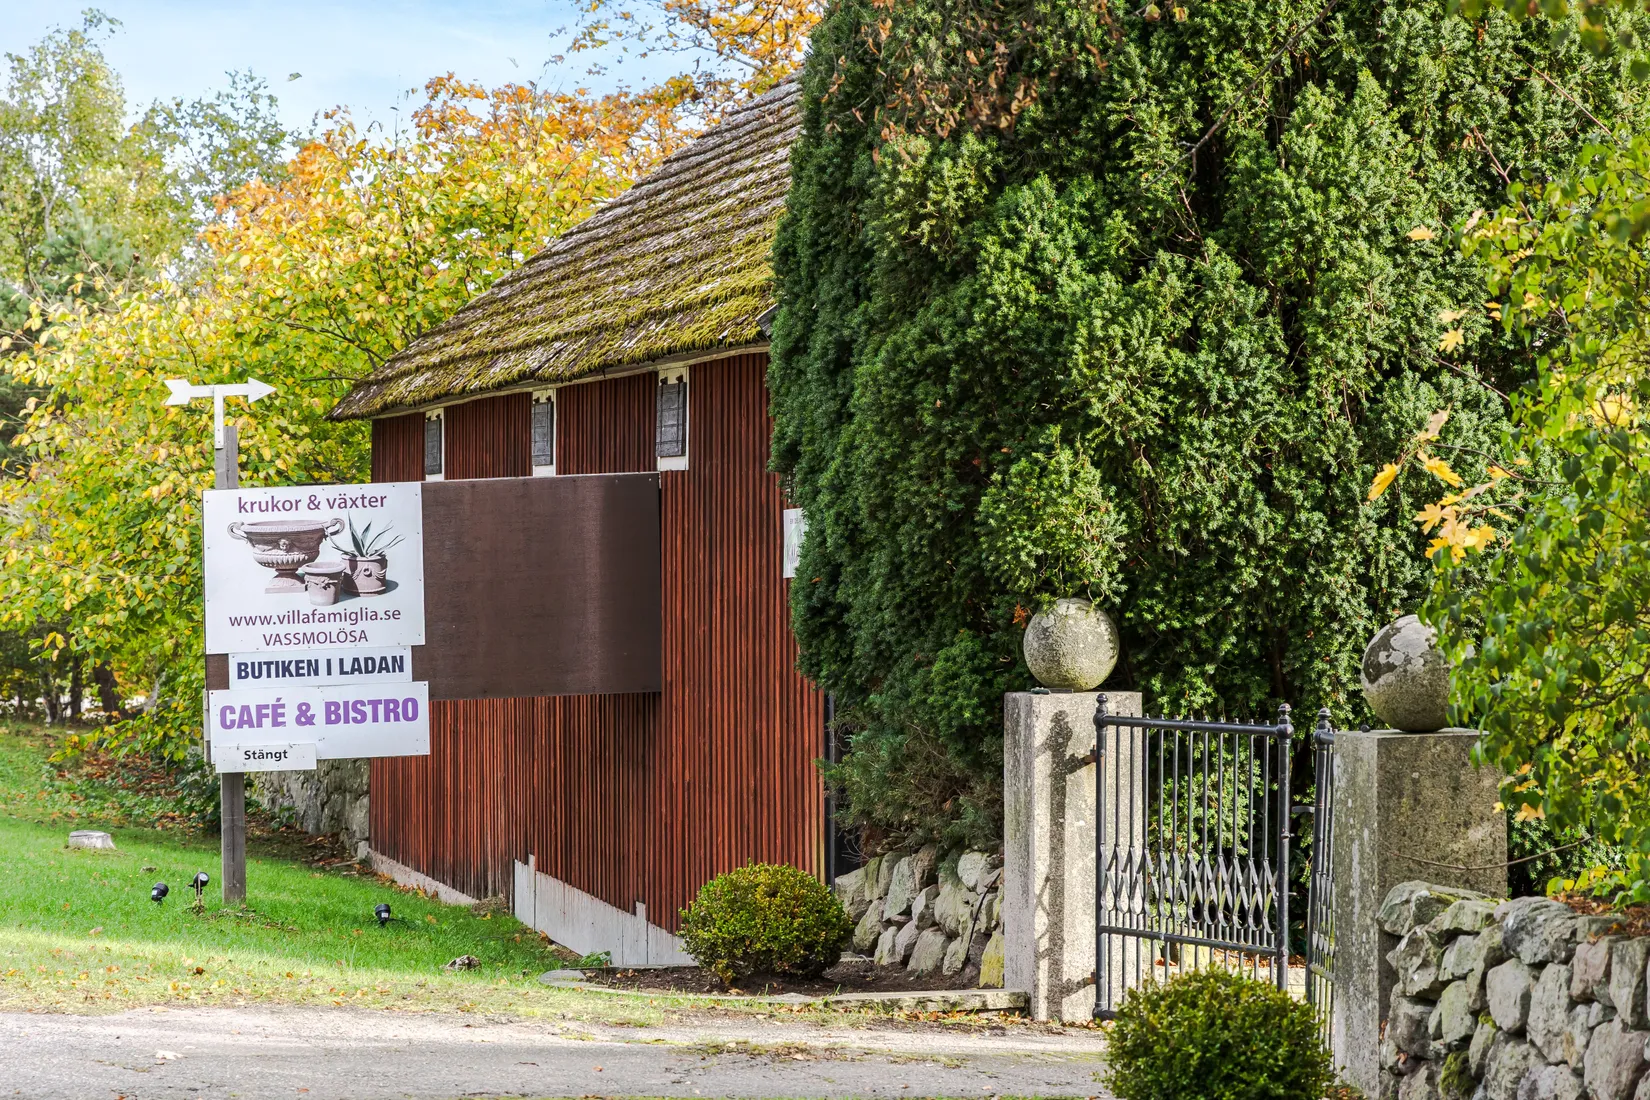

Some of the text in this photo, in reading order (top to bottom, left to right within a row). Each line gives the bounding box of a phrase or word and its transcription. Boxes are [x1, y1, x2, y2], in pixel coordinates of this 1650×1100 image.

[238, 493, 387, 513] krukor & växter
[229, 607, 401, 627] www.villafamiglia.se
[262, 629, 368, 646] VASSMOLÖSA
[237, 655, 404, 679] BUTIKEN I LADAN
[219, 697, 419, 729] CAFÉ & BISTRO
[244, 749, 288, 761] Stängt
